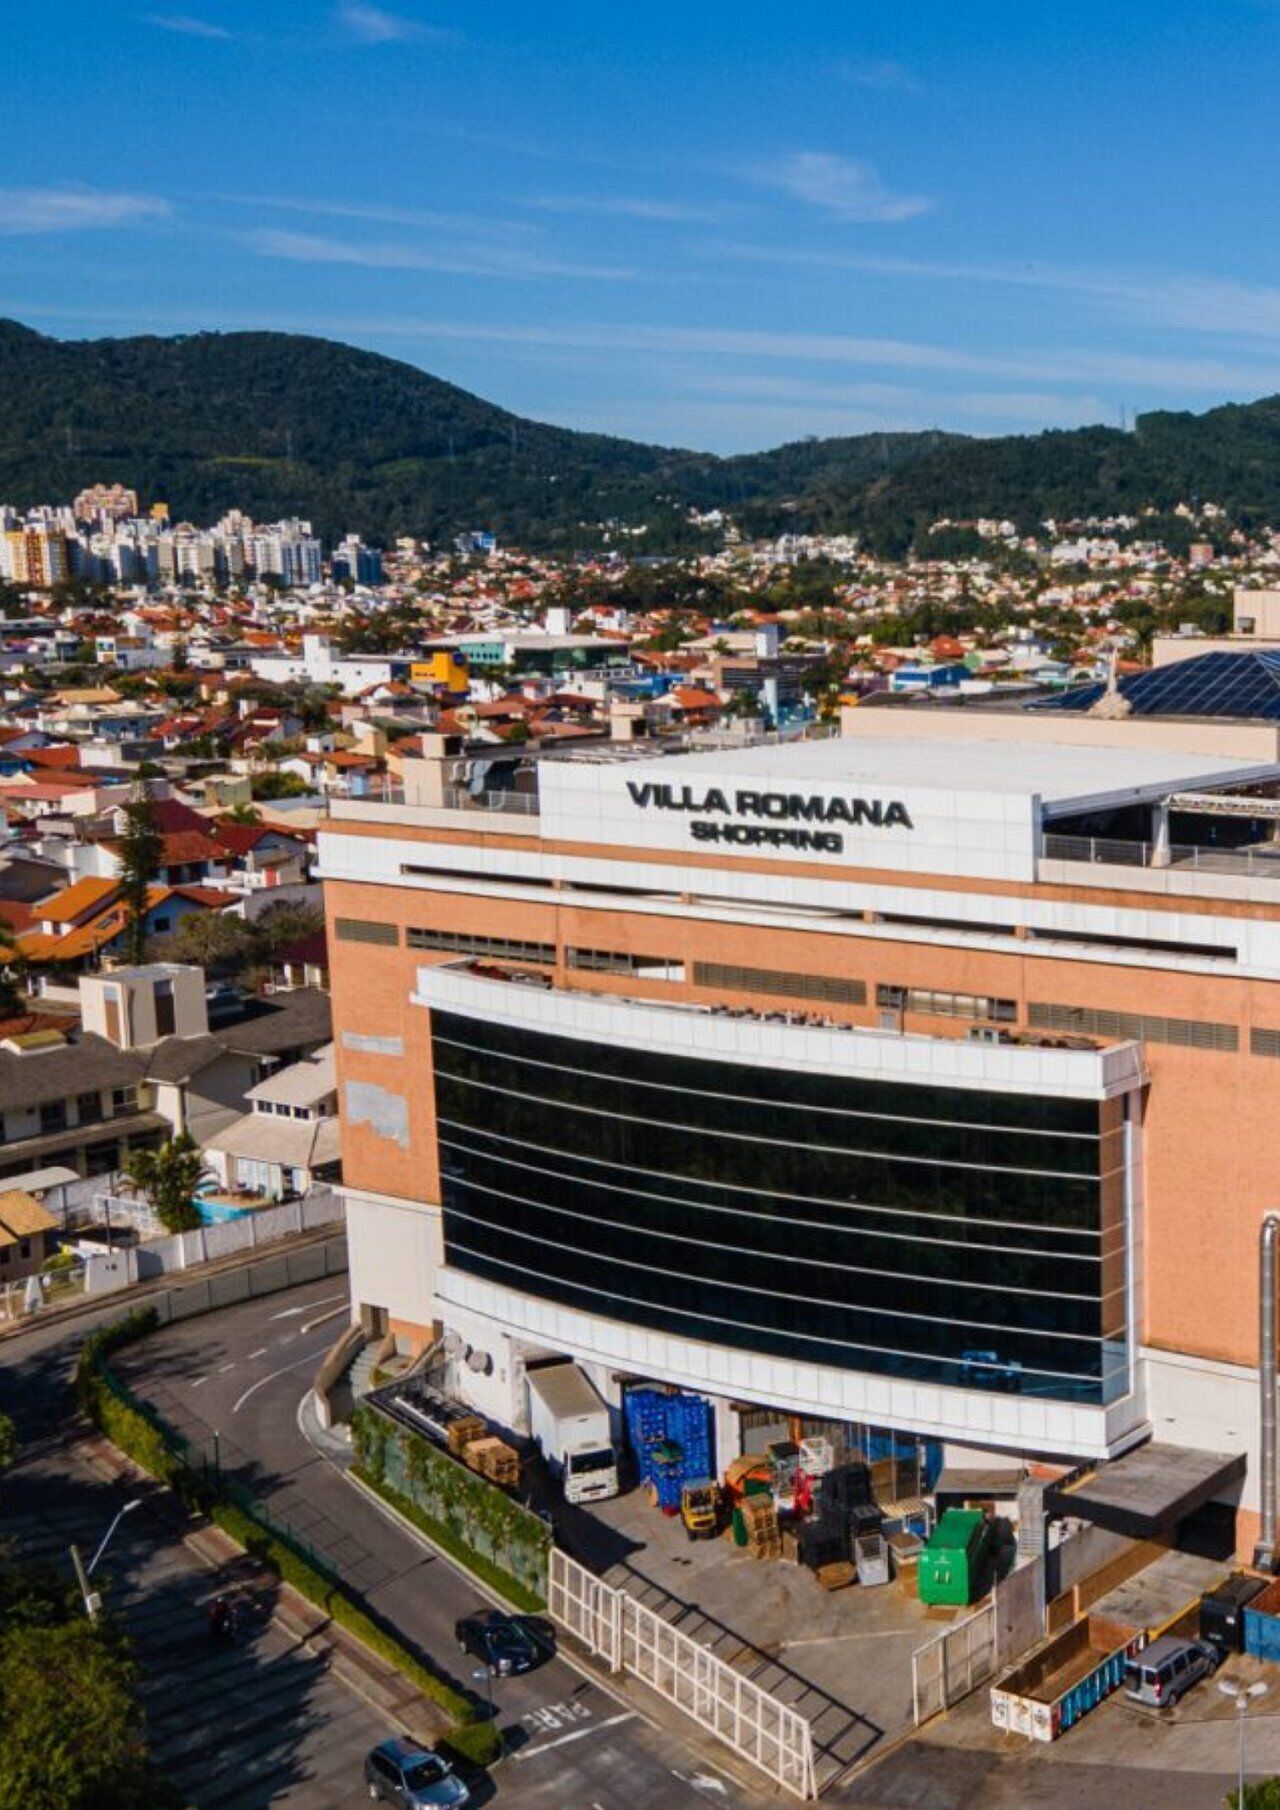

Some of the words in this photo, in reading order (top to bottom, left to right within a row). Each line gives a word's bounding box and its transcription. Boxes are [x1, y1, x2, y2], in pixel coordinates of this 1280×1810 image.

[626, 781, 732, 816] VILLA
[735, 790, 914, 829] ROMANA
[690, 821, 843, 853] SHOPPING
